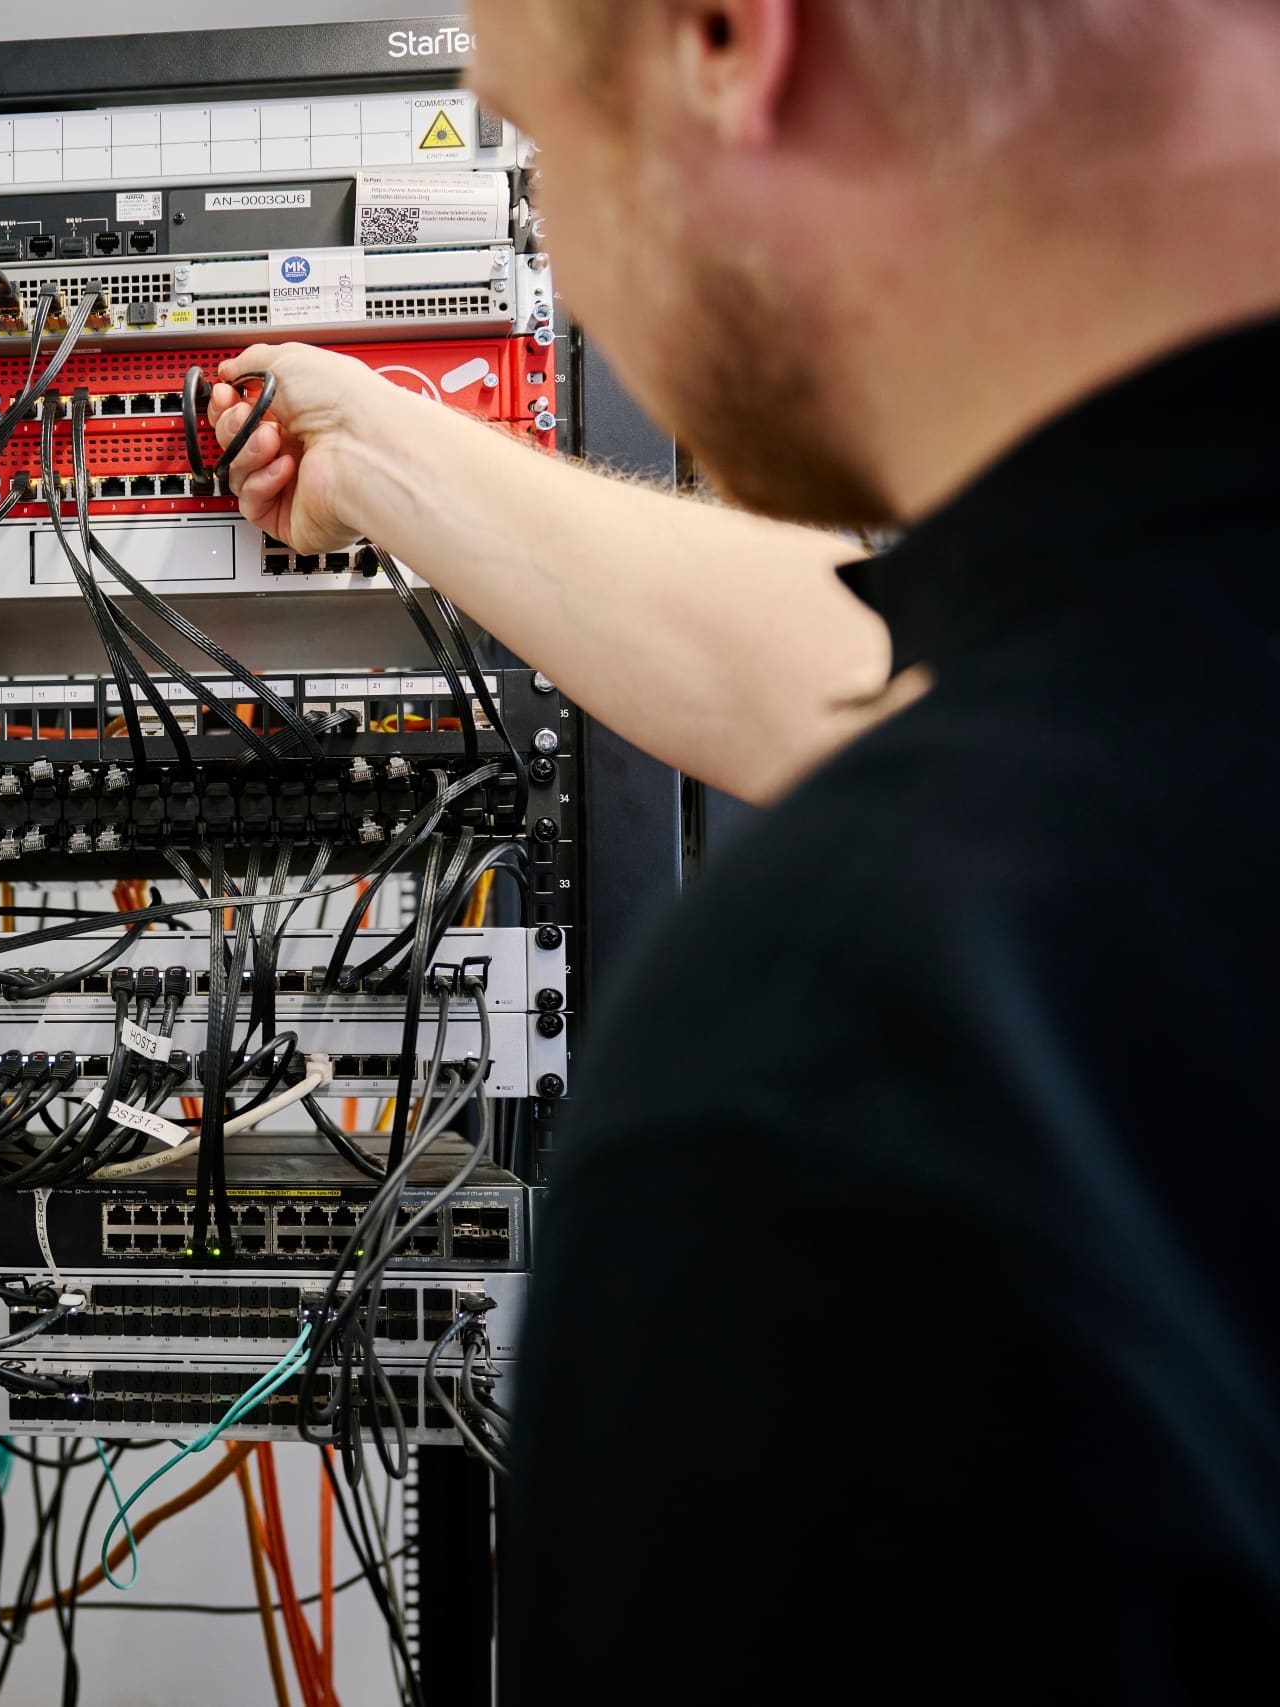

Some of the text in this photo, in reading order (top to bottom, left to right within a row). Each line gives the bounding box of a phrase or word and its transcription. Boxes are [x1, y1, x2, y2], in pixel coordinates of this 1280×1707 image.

[414, 99, 465, 108] COMMSCOPE
[211, 194, 306, 206] AN-0003QU6
[284, 261, 307, 273] MK
[273, 286, 320, 297] EIGENTUM
[554, 374, 566, 383] 39
[559, 879, 570, 889] 33
[130, 1029, 158, 1055] HOST3
[108, 1104, 165, 1133] OST31.2
